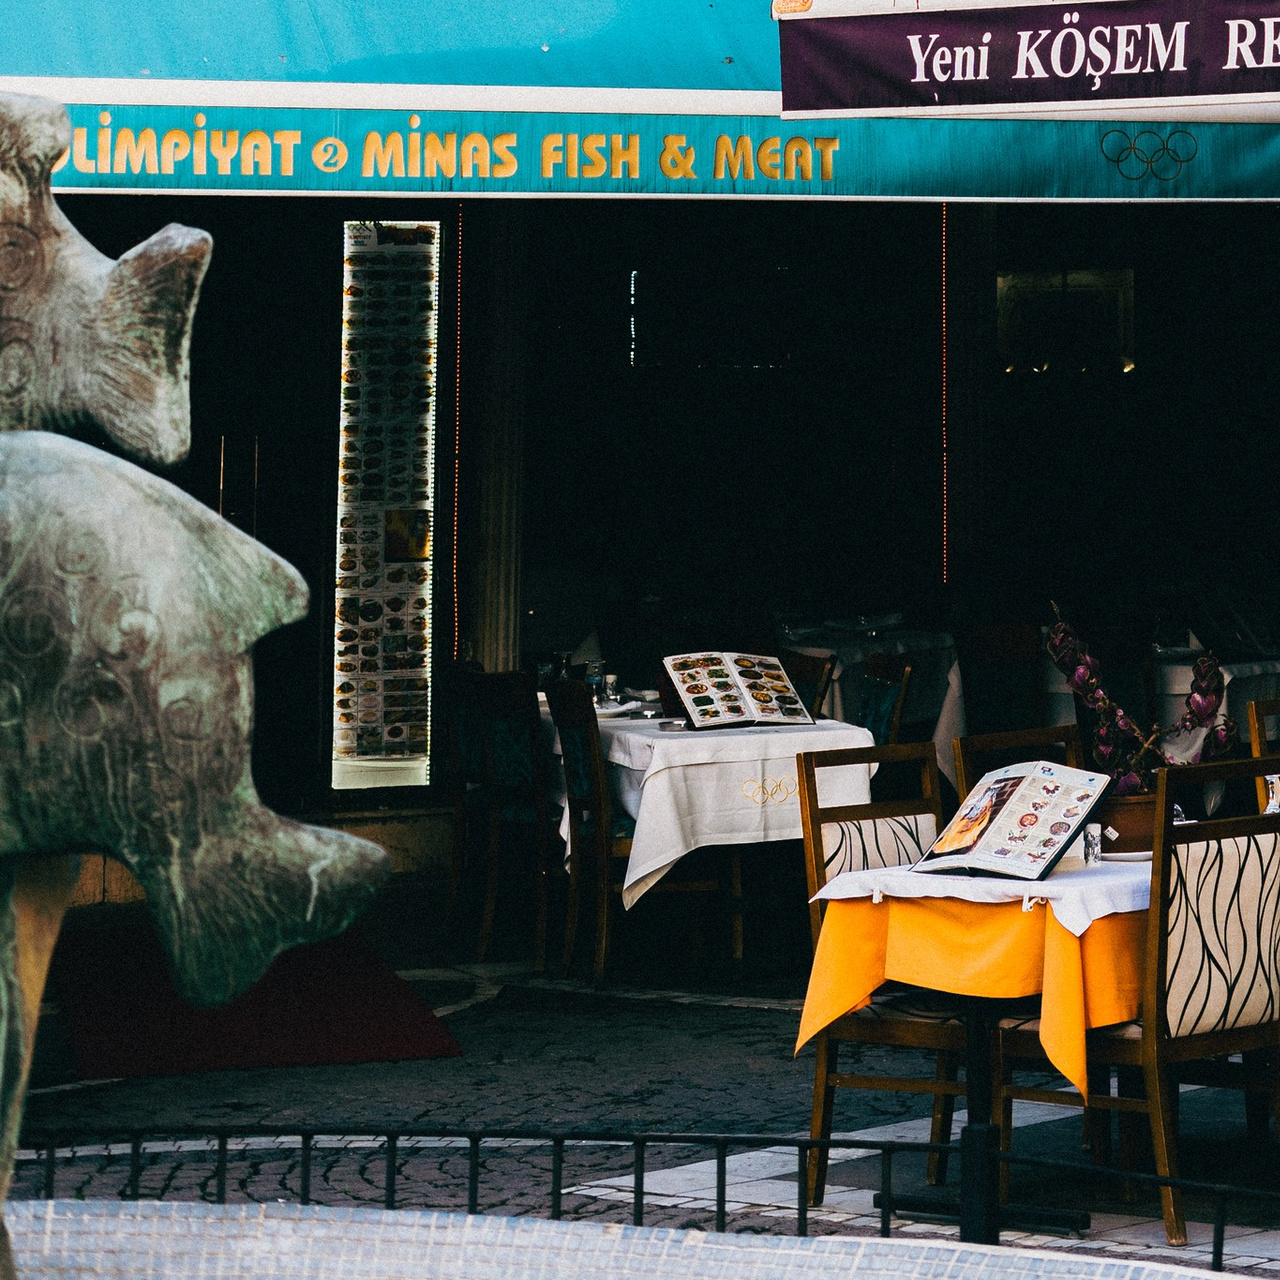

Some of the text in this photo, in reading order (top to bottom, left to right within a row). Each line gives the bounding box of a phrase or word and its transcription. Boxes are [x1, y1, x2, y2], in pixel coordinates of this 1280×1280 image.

[906, 31, 992, 83] Yeni
[1011, 13, 1191, 91] KÖŞEM
[51, 111, 302, 176] LİMPİYAT
[317, 140, 344, 171] 2
[541, 133, 640, 179] FISH
[660, 134, 697, 179] &
[715, 135, 840, 180] MEAT
